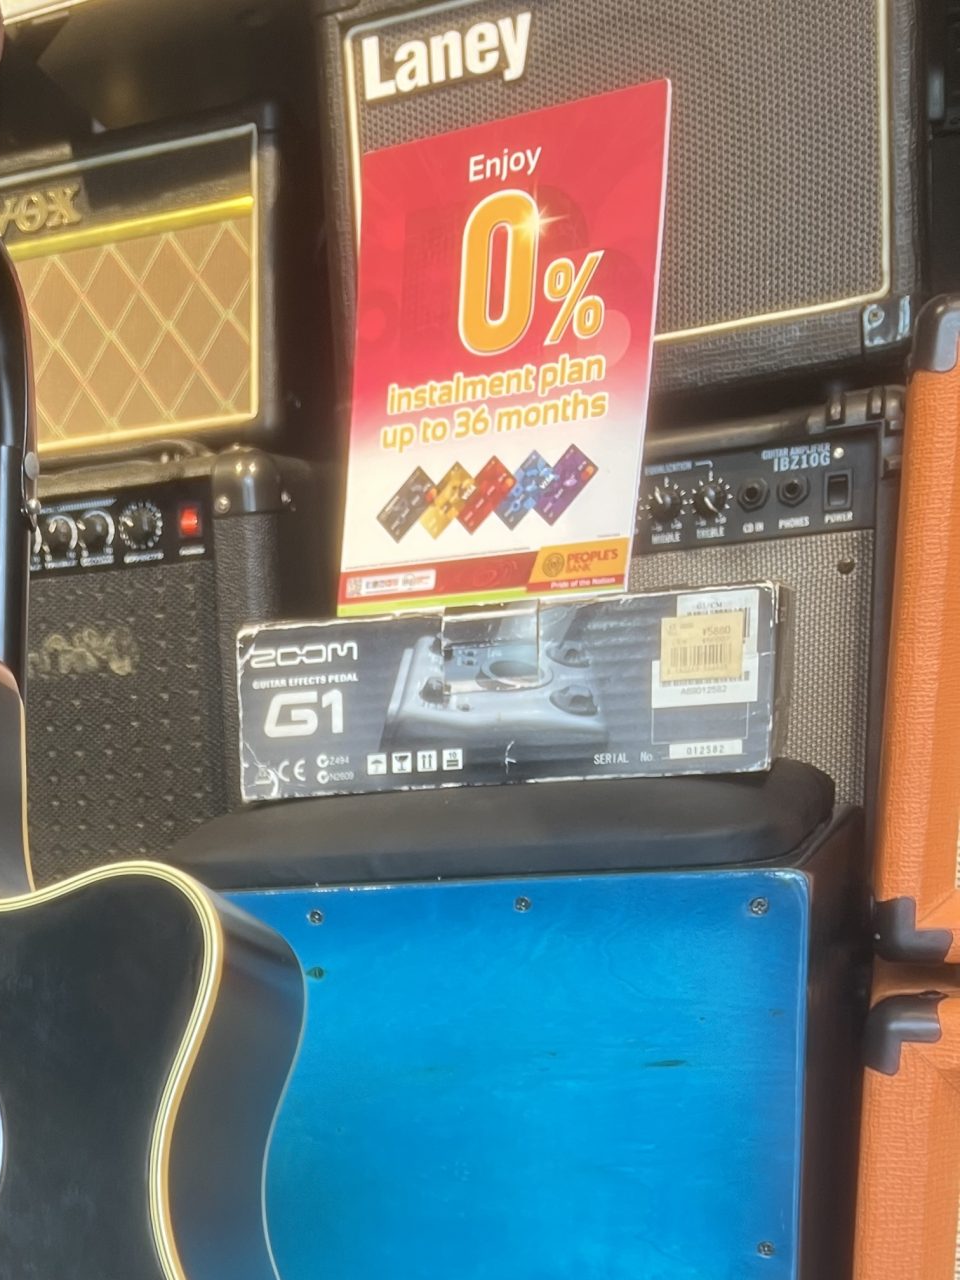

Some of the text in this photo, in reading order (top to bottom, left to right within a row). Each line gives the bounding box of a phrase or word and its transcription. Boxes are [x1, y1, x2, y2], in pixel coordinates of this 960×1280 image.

[362, 12, 531, 100] Laney
[469, 146, 542, 182] Enjoy
[458, 188, 605, 356] 0%
[538, 354, 606, 397] plan
[381, 390, 609, 453] up to 36 months
[773, 453, 830, 472] IBZ10G
[250, 641, 358, 669] ZOOM
[252, 672, 359, 690] GUITAR EFFECTS PEDAL
[264, 688, 344, 738] G1
[594, 752, 629, 765] SERIAL
